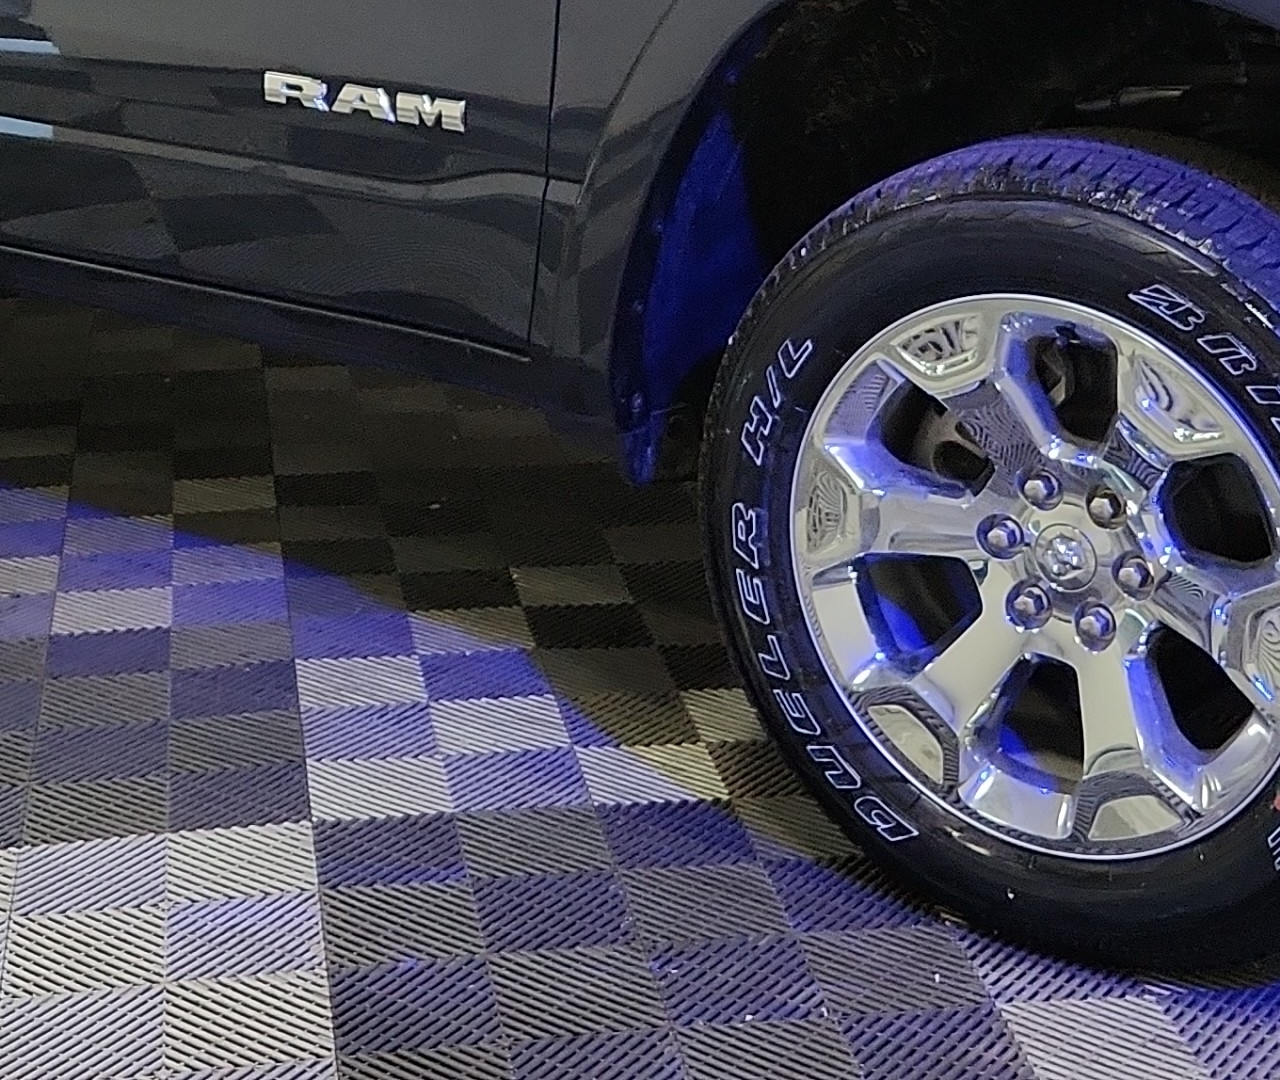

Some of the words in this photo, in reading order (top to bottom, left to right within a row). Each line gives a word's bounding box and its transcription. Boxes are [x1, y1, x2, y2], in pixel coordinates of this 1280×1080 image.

[264, 71, 466, 133] RAM
[741, 338, 812, 465] H/L
[731, 502, 919, 842] DUELER
